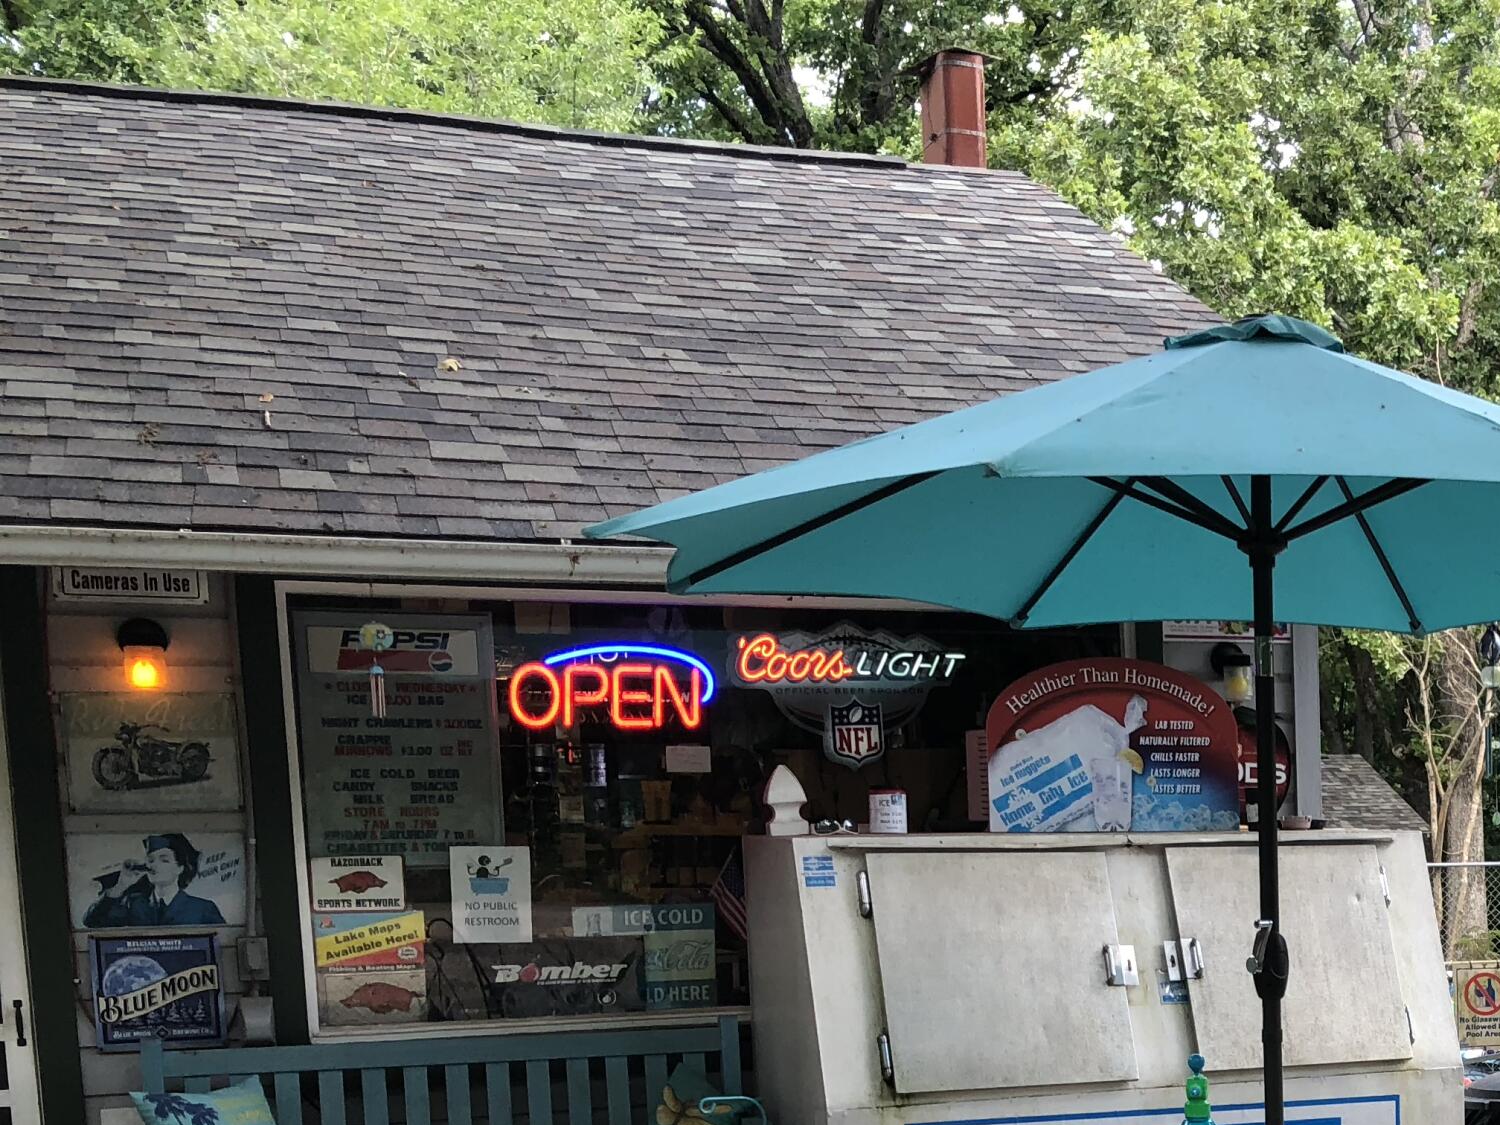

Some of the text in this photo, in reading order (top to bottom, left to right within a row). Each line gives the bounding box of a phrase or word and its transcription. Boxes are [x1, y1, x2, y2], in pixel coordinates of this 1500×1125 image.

[71, 569, 191, 593] Cameras In Use
[341, 630, 451, 650] PPSI
[737, 633, 966, 682] Coors LIGHT
[509, 661, 702, 729] OPEN
[776, 687, 829, 695] OFFICIAL
[1005, 667, 1216, 718] Healthier Than Homemade!
[347, 694, 367, 705] ICE
[417, 695, 445, 706] BAG
[1154, 720, 1194, 730] LAB TESTED
[836, 726, 879, 756] NFL
[1139, 736, 1210, 746] NATURALLY FILTERED
[1150, 752, 1200, 762] CHILLS FASTER
[1014, 754, 1052, 781] nuggets
[1150, 768, 1200, 778] LASTS LONGER
[350, 768, 460, 779] ICE COLD BEER
[333, 781, 458, 792] CANDY SNACKS
[1176, 783, 1201, 794] BETTER
[410, 794, 455, 804] BREAD
[999, 800, 1037, 827] Home
[1038, 784, 1065, 806] City
[1067, 770, 1089, 789] Ice
[344, 806, 440, 817] STORE HOURS
[330, 857, 384, 867] RAZORBACK
[317, 898, 401, 908] SPORTS NETWORK
[464, 902, 518, 911] NO PUBLIC
[464, 917, 520, 926] RESTROOM
[624, 909, 703, 927] ICE COLD
[334, 921, 402, 945] Lake Maps
[126, 938, 182, 948] BELGIAN WHITE
[326, 938, 382, 960] Available
[385, 930, 419, 946] Here!
[669, 985, 709, 1001] HERE
